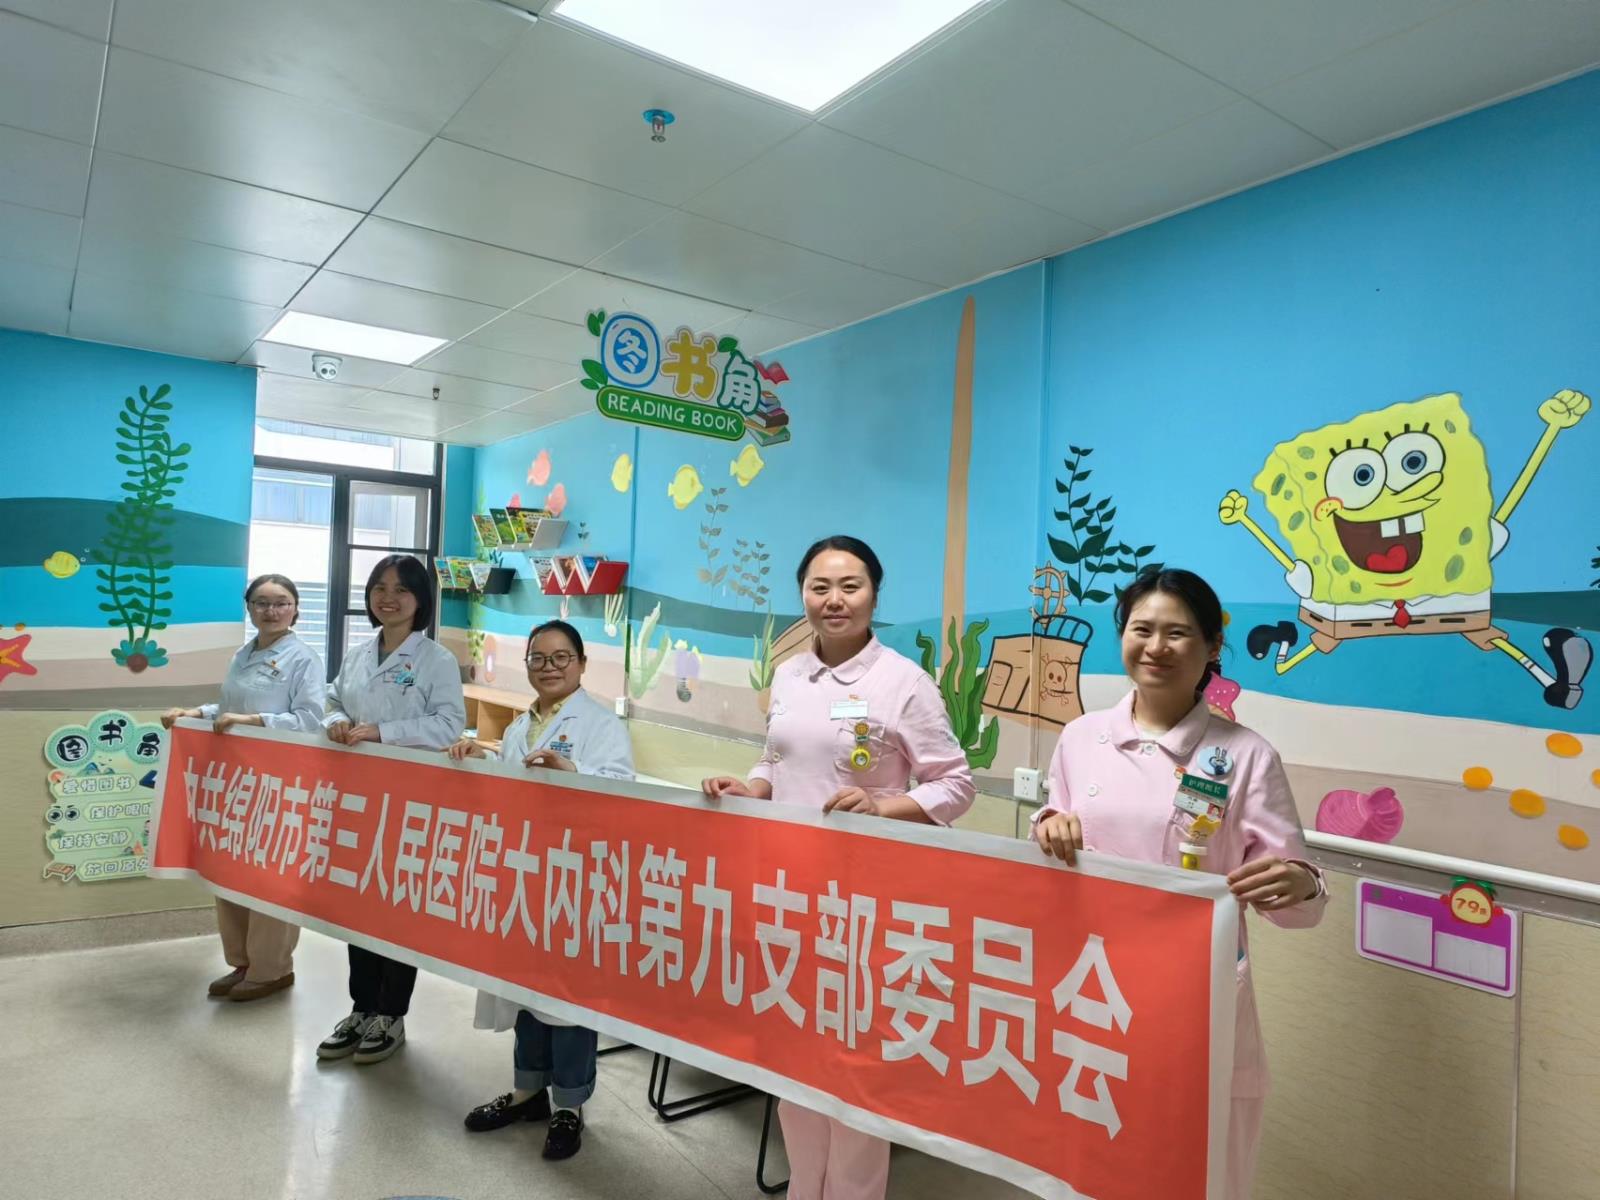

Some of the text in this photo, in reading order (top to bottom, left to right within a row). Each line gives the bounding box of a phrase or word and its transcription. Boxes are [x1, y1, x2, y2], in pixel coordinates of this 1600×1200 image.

[600, 312, 762, 416] 图书角
[607, 392, 738, 434] READING BOOK
[56, 718, 161, 762] 图书角
